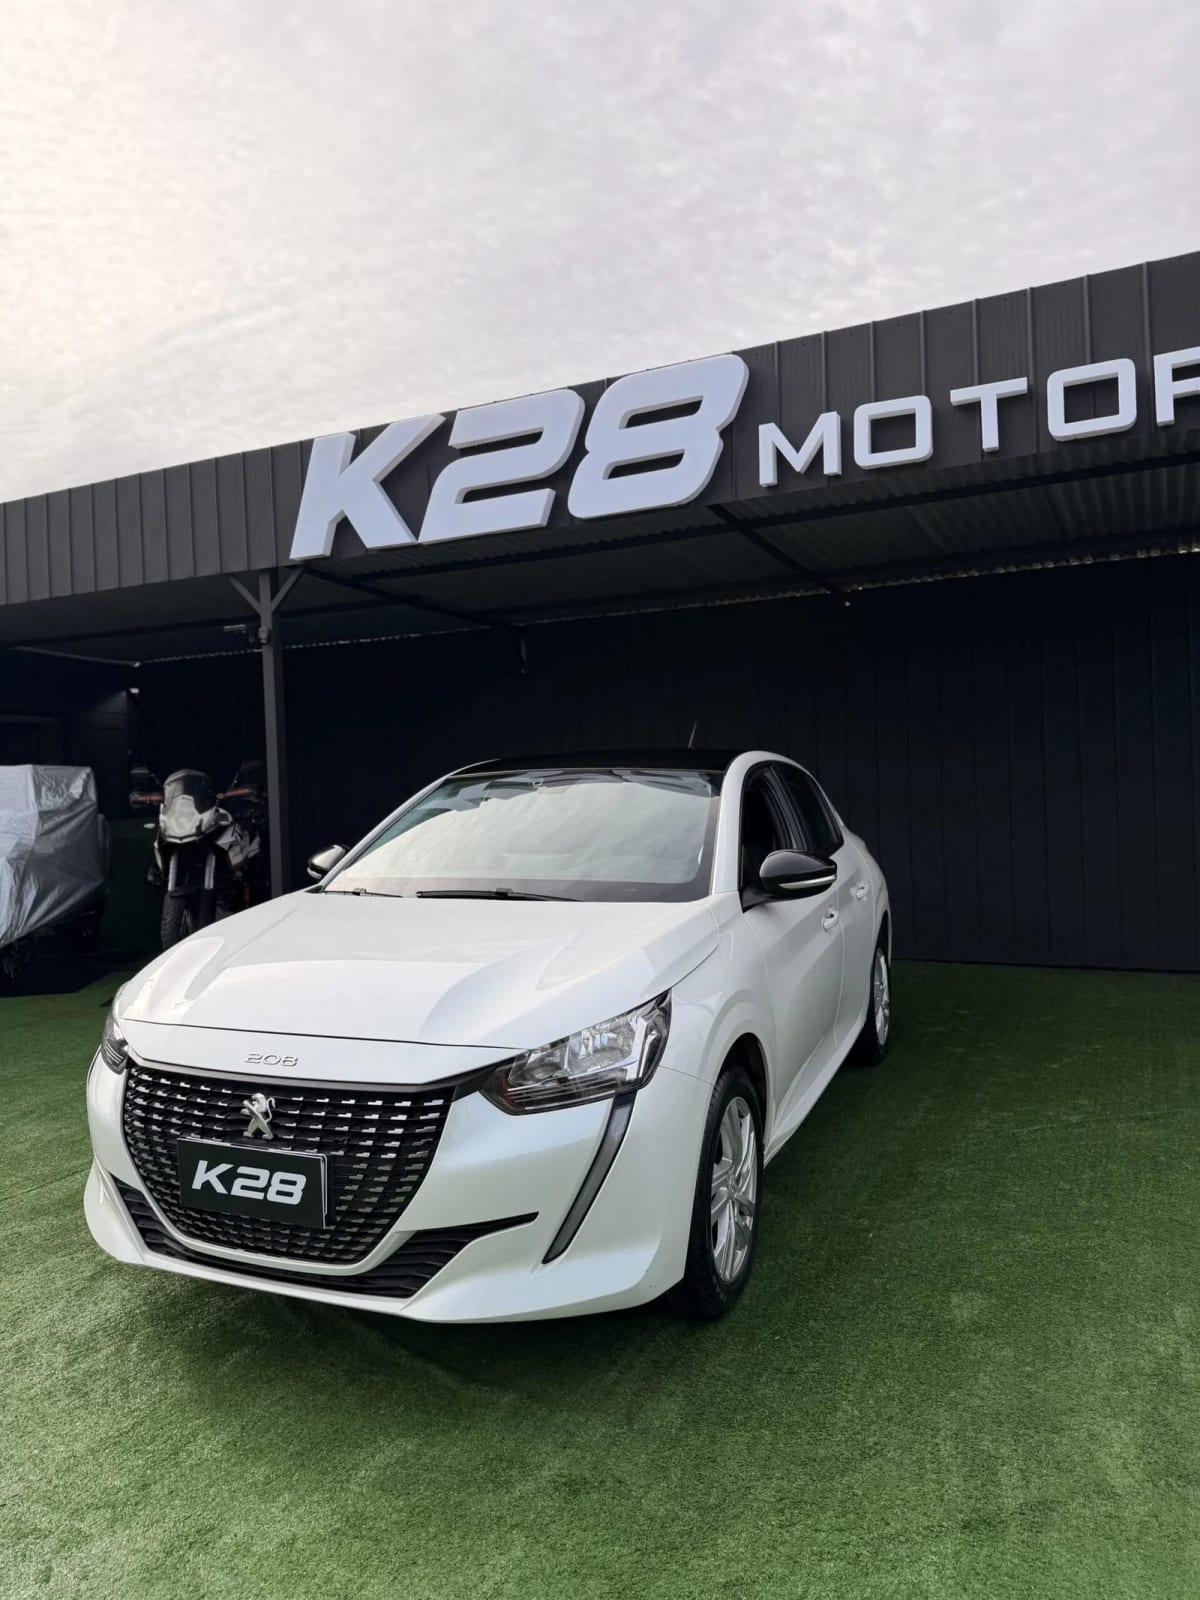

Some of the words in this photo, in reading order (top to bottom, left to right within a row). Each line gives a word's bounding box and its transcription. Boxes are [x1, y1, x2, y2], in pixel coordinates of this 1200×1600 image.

[289, 354, 749, 560] K28
[244, 1052, 299, 1067] 208
[191, 1159, 307, 1206] K28
